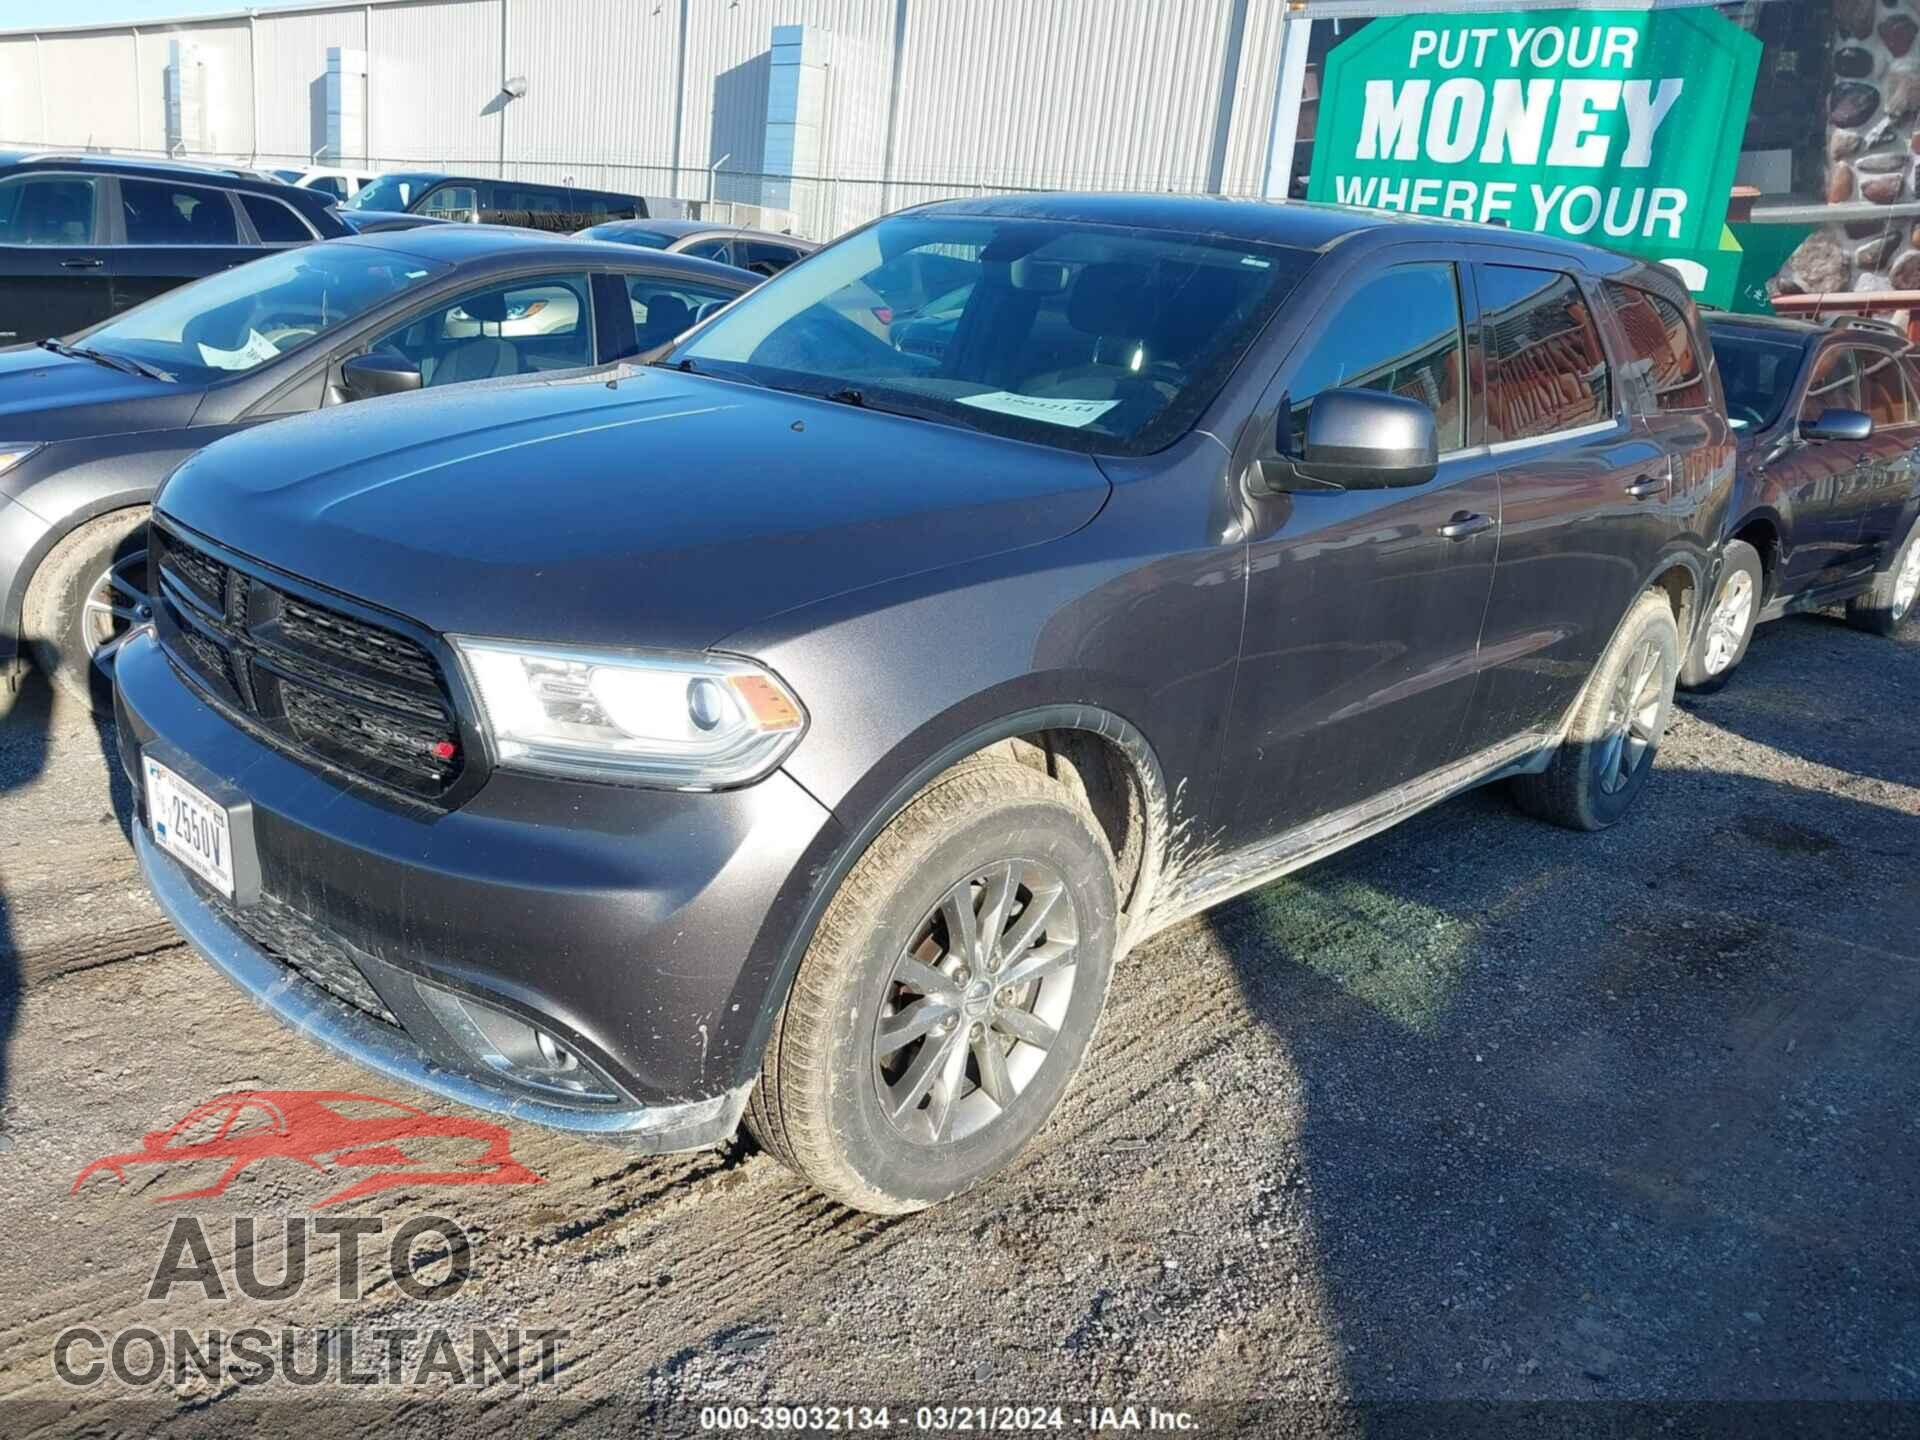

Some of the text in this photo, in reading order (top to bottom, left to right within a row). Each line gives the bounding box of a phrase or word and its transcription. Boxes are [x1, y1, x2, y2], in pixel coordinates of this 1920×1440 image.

[1409, 26, 1638, 69] PUT YOUR
[1355, 77, 1684, 168] MONEY
[1530, 184, 1688, 239] YOUR
